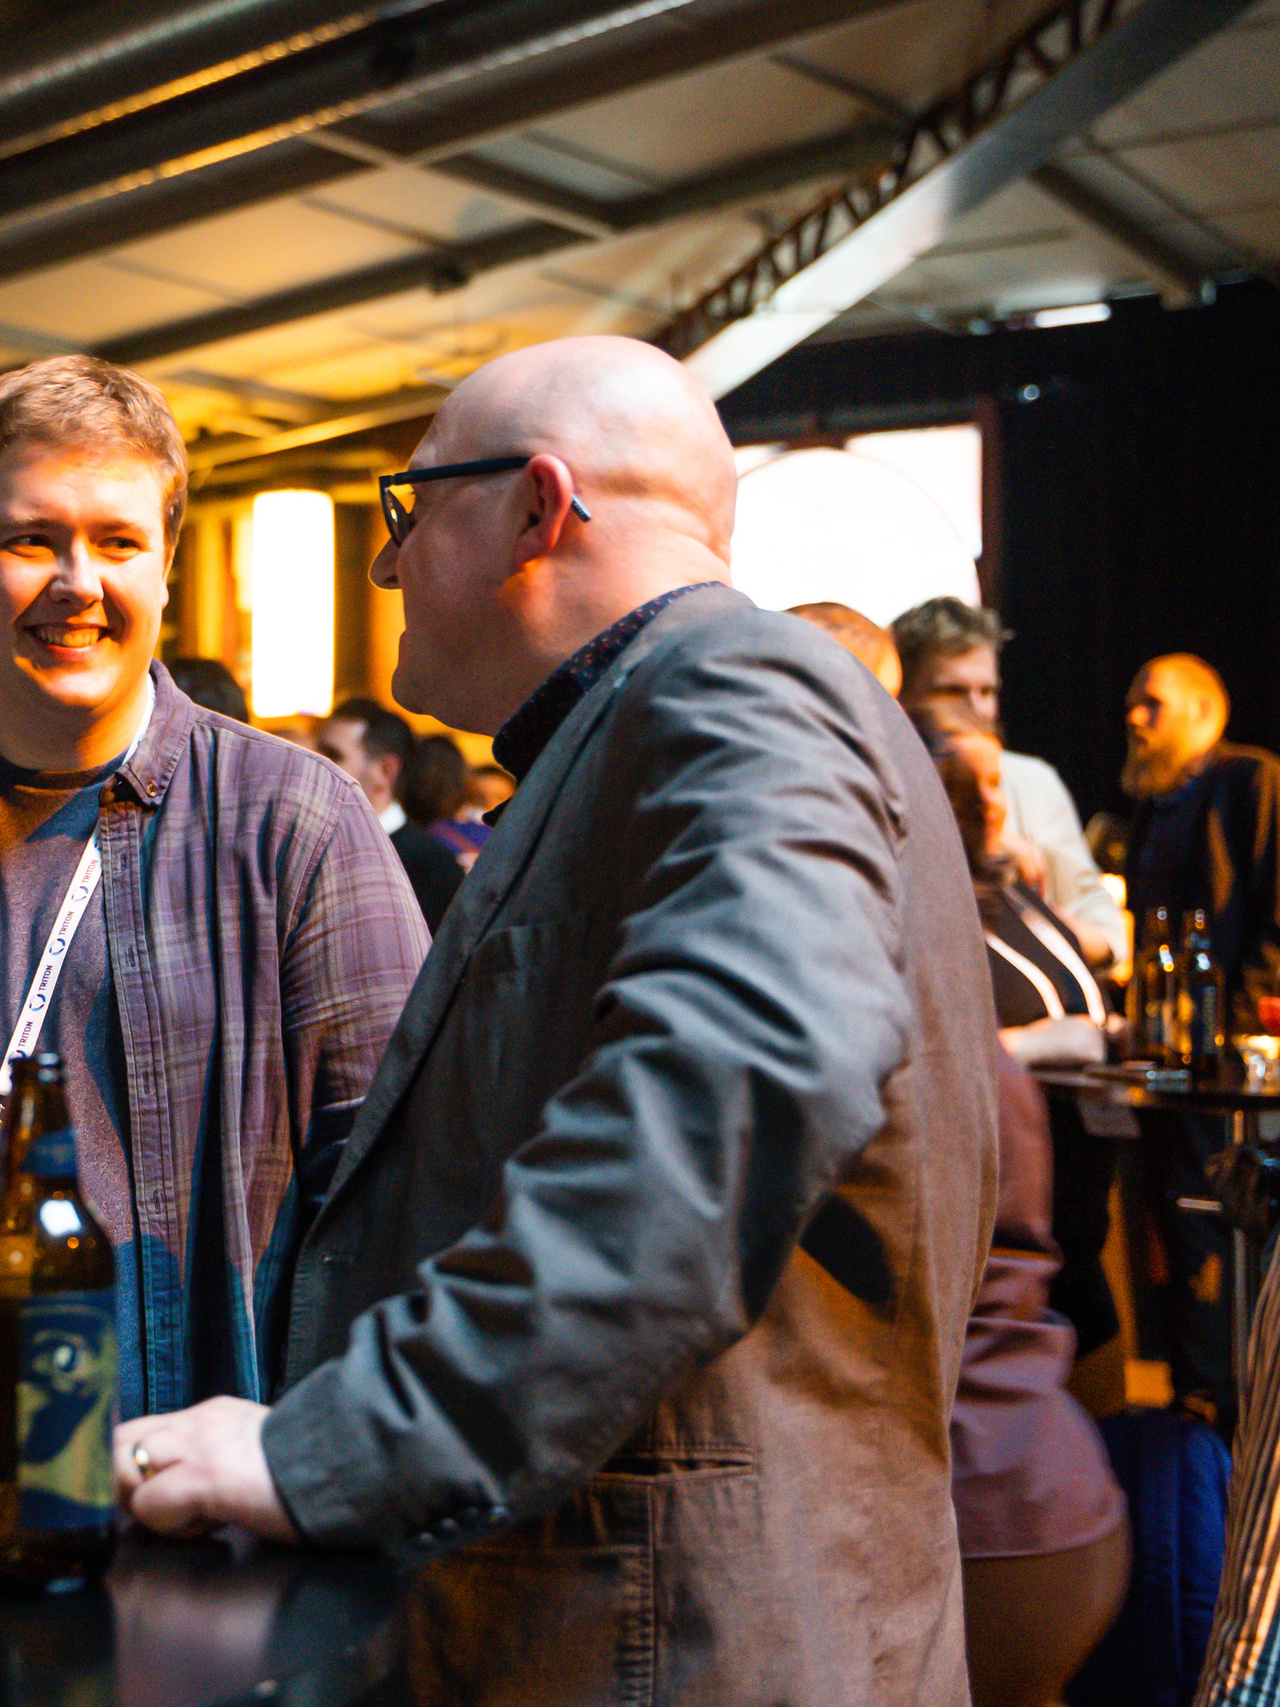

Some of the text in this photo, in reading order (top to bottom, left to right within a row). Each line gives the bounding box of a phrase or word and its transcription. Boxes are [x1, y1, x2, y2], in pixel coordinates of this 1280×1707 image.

[82, 859, 99, 884] TRITON
[59, 911, 75, 936] TRITON
[39, 964, 53, 991] TRITON
[18, 1020, 33, 1047] TRITON
